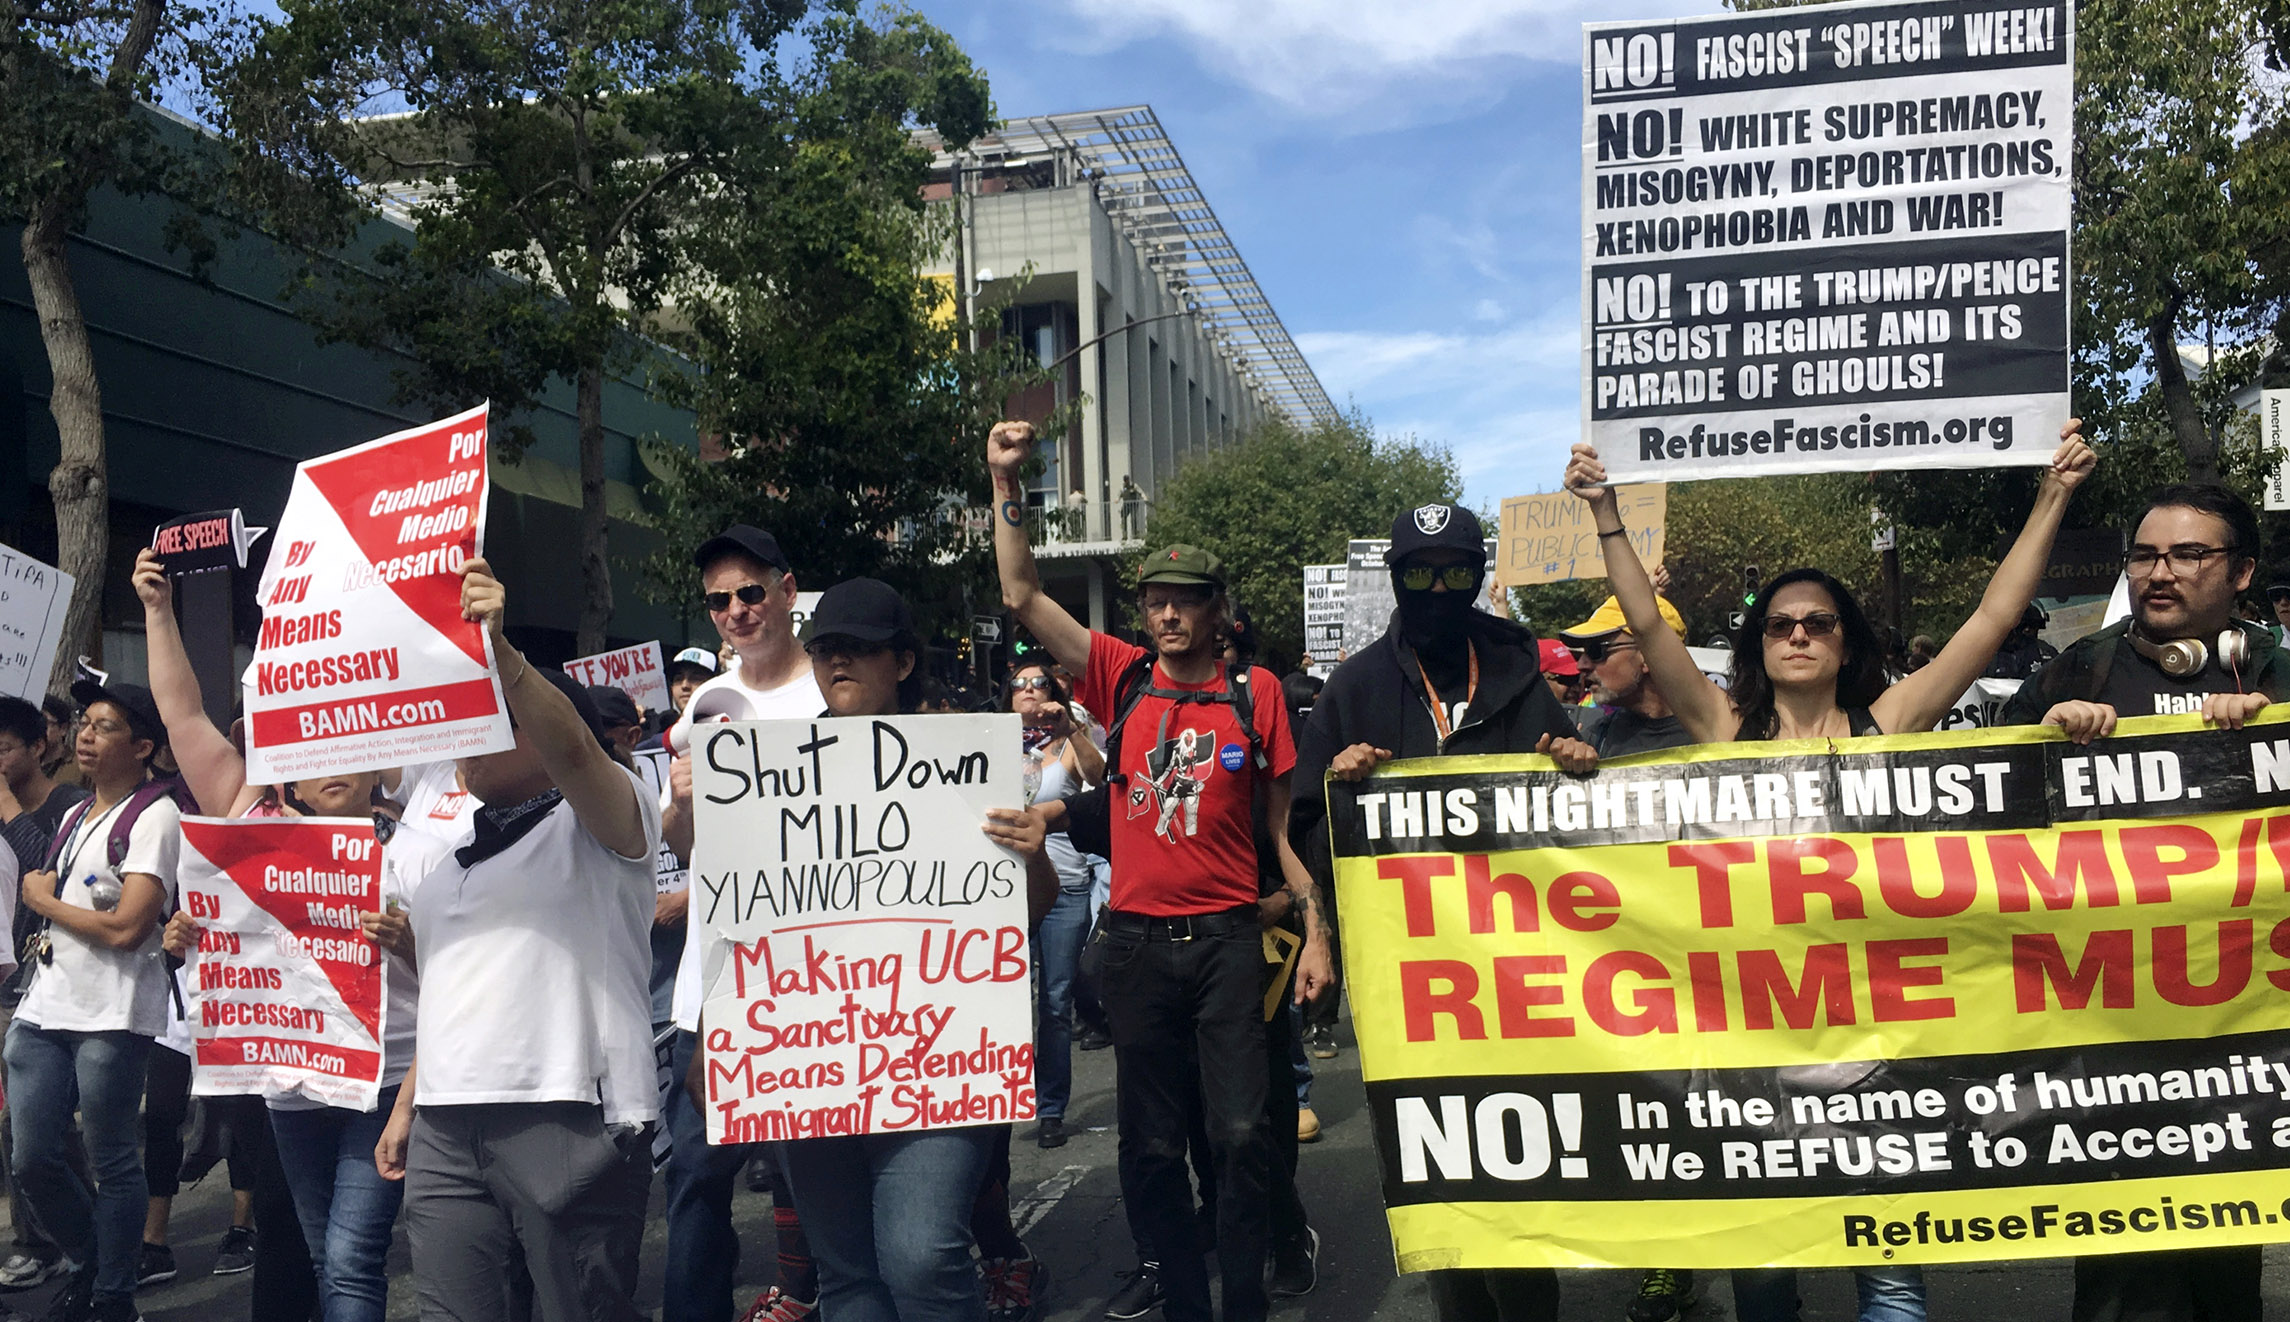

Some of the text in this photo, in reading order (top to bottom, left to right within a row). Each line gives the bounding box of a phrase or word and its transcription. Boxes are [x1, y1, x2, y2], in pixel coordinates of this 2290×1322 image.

[1595, 8, 2055, 89] NO! FASCIST “SPEECH” WEEK!
[1597, 90, 2045, 162] NO! WHITE SUPREMACY,
[1597, 139, 2062, 210] MISOGYNY, DEPORTATIONS,
[1596, 192, 2003, 257] XENOPHOBIA AND WAR!
[1597, 257, 2060, 322] NO! TO THE TRUMP/PENCE
[1596, 304, 2022, 366] FASCIST REGIME AND ITS
[1597, 353, 1944, 409] PARADE OF GHOULS!
[449, 428, 484, 463] Por
[1639, 413, 2012, 461] RefuseFascism.org
[2270, 397, 2282, 447] America
[369, 469, 480, 517] Cualquier
[184, 518, 229, 551] SPEECH
[397, 506, 467, 544] Medio
[285, 541, 316, 569] By
[343, 545, 464, 592] Necesario
[1511, 533, 1593, 567] PUBLIC
[266, 575, 312, 608] Any
[1307, 569, 1327, 582] NO!
[1308, 587, 1328, 599] NO!
[260, 610, 341, 650] Means
[1309, 626, 1340, 640] NO! TO
[258, 647, 399, 697] Necessary
[600, 647, 656, 685] YOU'RE
[299, 699, 446, 738] BAMN.com
[264, 753, 294, 763] Coalition
[304, 747, 328, 756] Defend
[330, 742, 366, 753] Affirmative
[395, 733, 435, 745] Integration
[437, 730, 450, 738] and
[452, 725, 492, 736] Immigrant
[273, 764, 294, 774] Rights
[296, 762, 308, 770] and
[310, 759, 326, 769] Fight
[339, 754, 365, 765] Equality
[367, 753, 376, 762] By
[378, 751, 392, 759] Any
[394, 748, 418, 757] Means
[420, 742, 456, 753] Necessary
[458, 737, 487, 748] (BAMN)
[705, 724, 839, 804] Shut
[873, 721, 990, 792] Down
[1356, 788, 1479, 840] THIS
[1495, 771, 1823, 834] NIGHTMARE
[1840, 761, 2011, 817] MUST
[2061, 751, 2202, 808] END.
[332, 833, 374, 861] Por
[782, 801, 910, 862] MILO
[264, 865, 372, 897] Cualquier
[701, 860, 1017, 925] YIANNOPOULOS
[1377, 854, 1622, 938] The
[187, 891, 220, 920] By
[306, 901, 369, 930] Medi
[197, 928, 241, 954] Any
[199, 962, 282, 991] Means
[733, 926, 1027, 1016] Making UCB
[1400, 937, 1956, 1043] REGIME
[201, 1000, 324, 1034] Necessary
[707, 993, 957, 1056] a Sanctuary
[242, 1041, 345, 1074] BAMN.com
[708, 1027, 1034, 1102] Means Defending
[717, 1070, 1036, 1145] Immigrant Students
[1618, 1092, 1668, 1130] In
[1685, 1089, 1774, 1127] the
[1793, 1087, 1947, 1125] name
[1964, 1073, 2017, 1115] of
[1396, 1092, 1589, 1182] NO!
[1620, 1143, 1704, 1181] We
[1722, 1132, 1952, 1179] REFUSE
[1968, 1132, 2027, 1169] to
[2048, 1113, 2252, 1164] Accept
